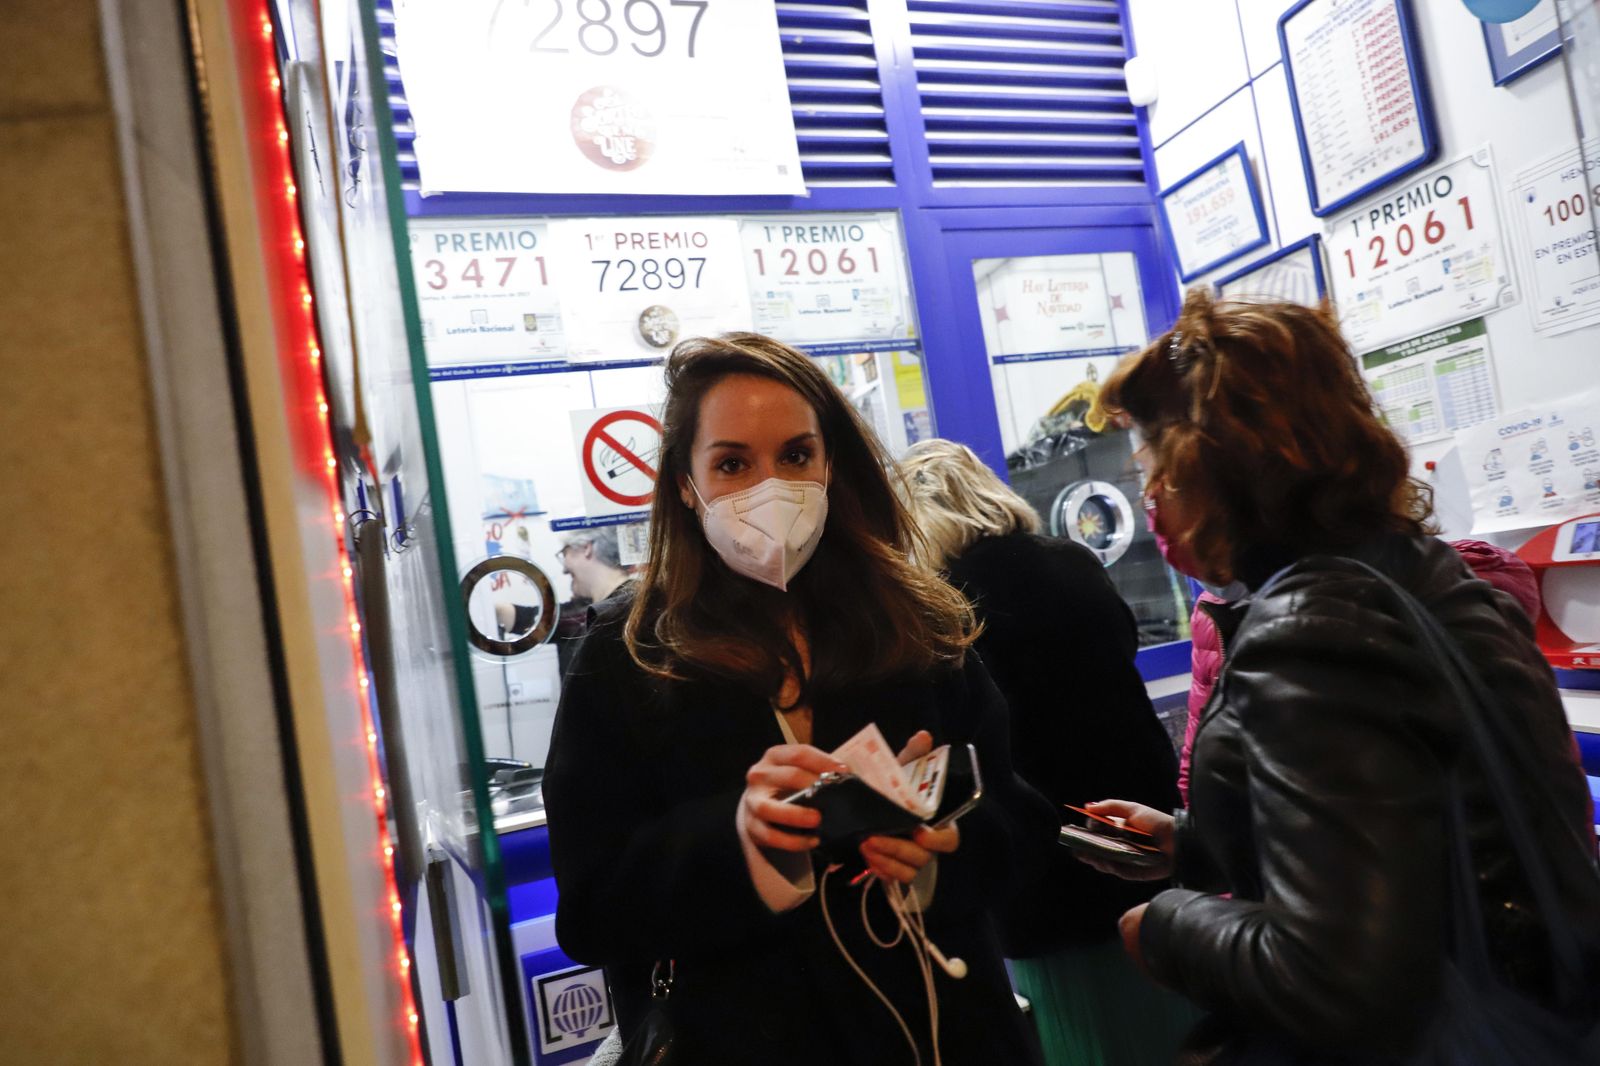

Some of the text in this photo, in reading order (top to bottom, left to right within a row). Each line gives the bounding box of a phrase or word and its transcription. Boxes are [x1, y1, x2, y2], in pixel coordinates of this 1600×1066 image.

[1369, 175, 1453, 231] PREMIO
[434, 231, 537, 253] PREMIO
[614, 231, 708, 250] PREMIO
[782, 225, 865, 243] PREMIO
[1344, 196, 1475, 279] 12061
[753, 247, 880, 276] 12061
[1535, 248, 1550, 260] EN
[1556, 253, 1572, 265] EN
[591, 257, 707, 293] 72897
